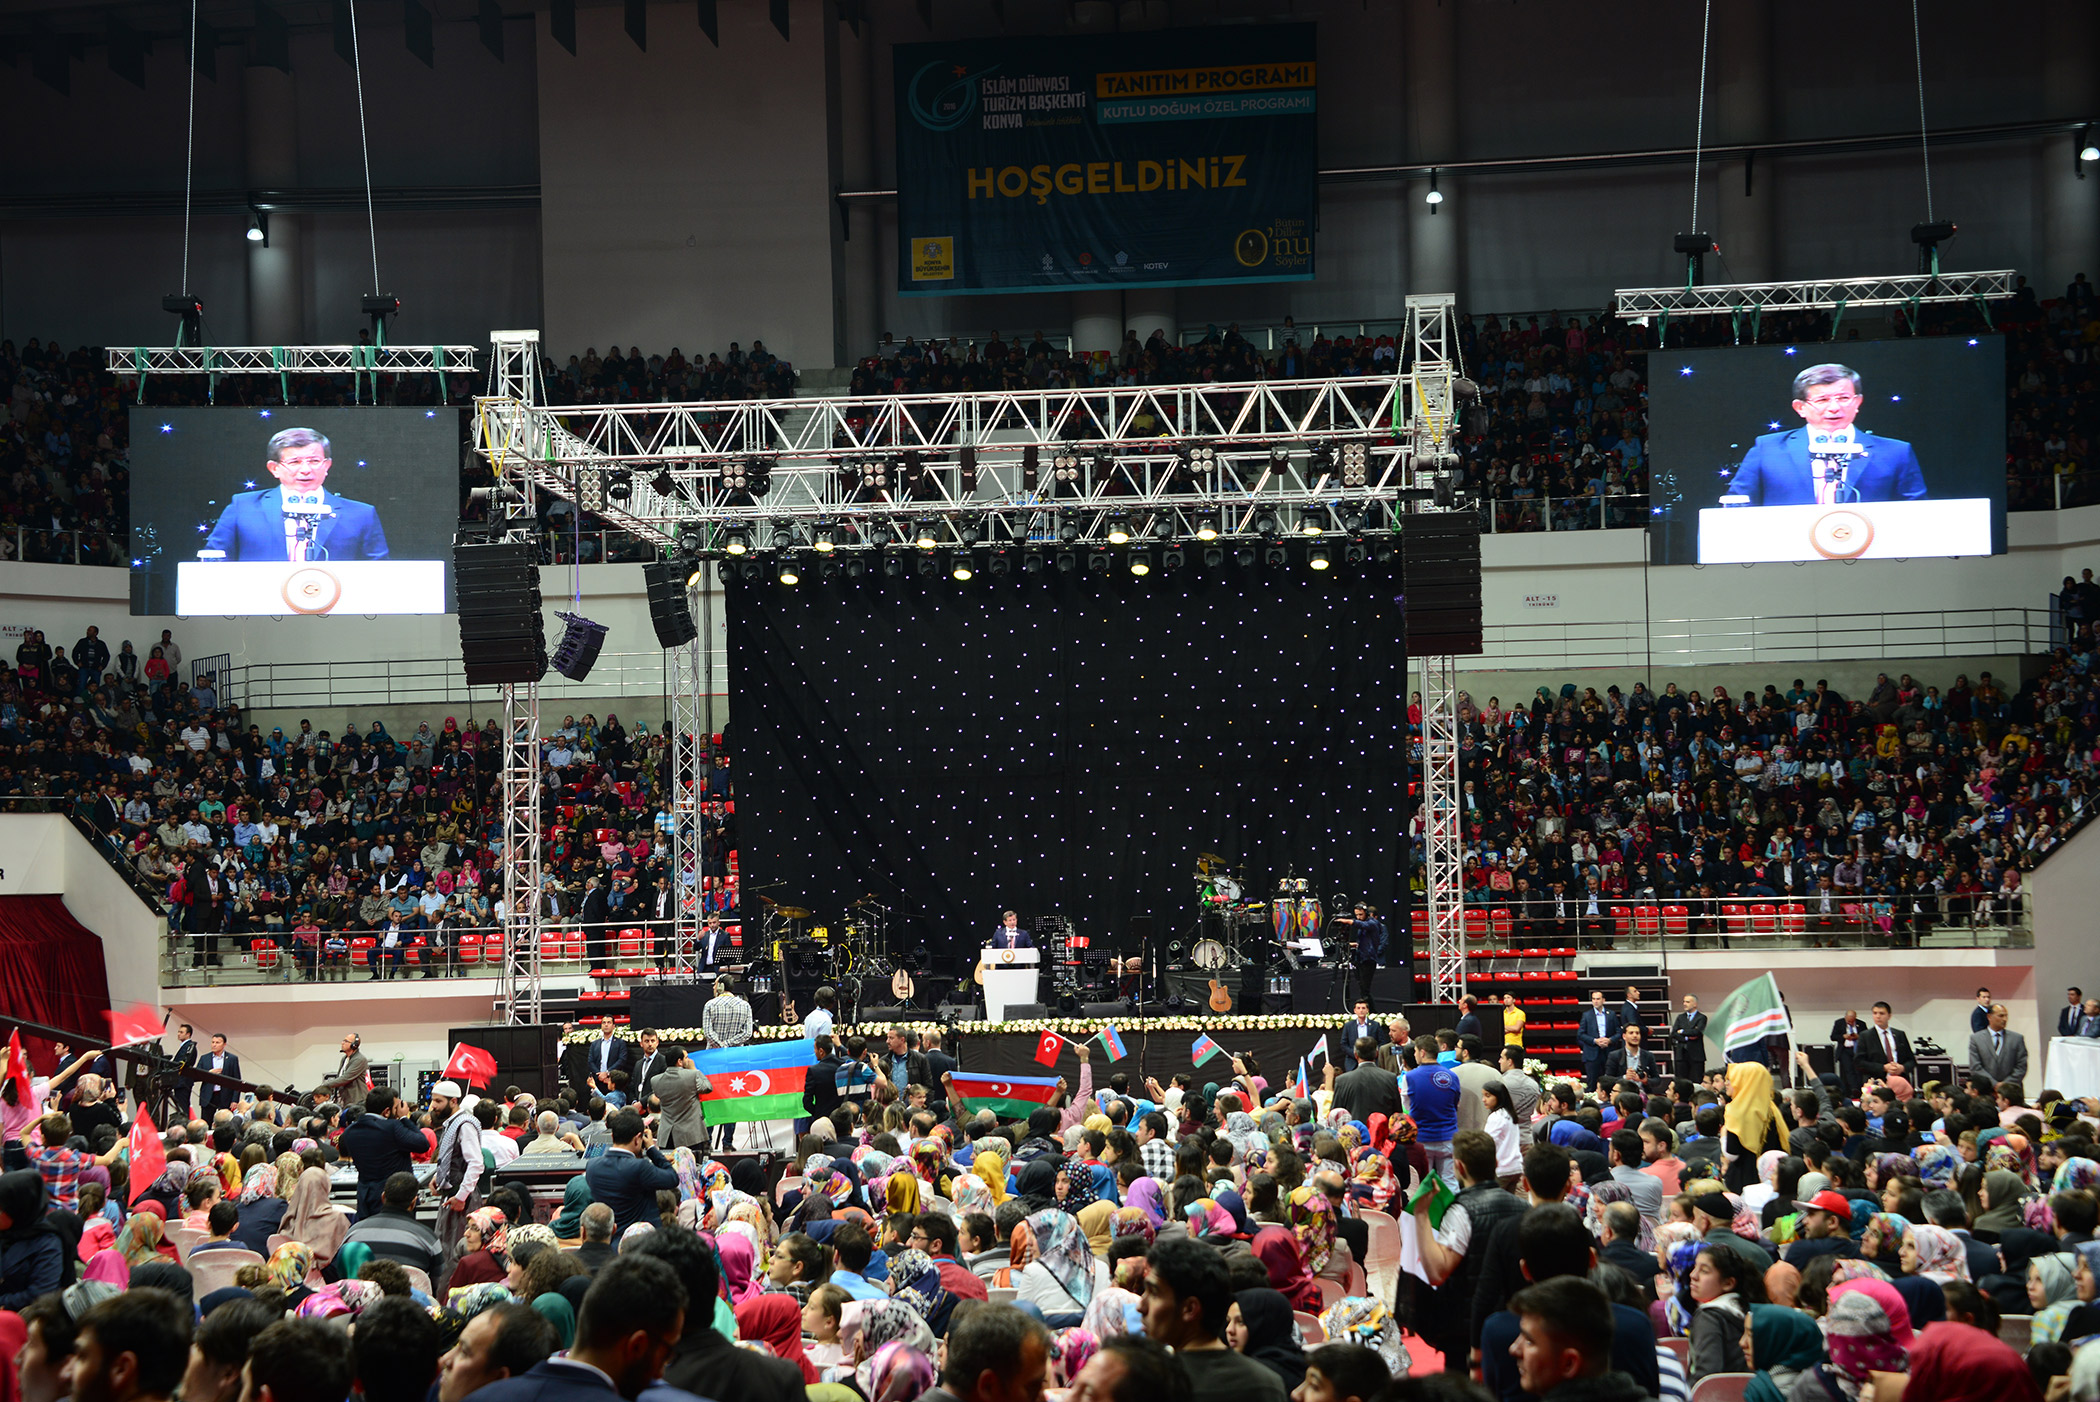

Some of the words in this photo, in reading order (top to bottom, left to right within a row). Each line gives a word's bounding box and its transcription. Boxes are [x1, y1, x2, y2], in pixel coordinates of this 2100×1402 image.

[1019, 74, 1069, 93] DÜNYASI
[1103, 74, 1189, 94] TANITIM
[1195, 65, 1310, 89] PROGRAMI
[1103, 105, 1146, 119] KUTLU
[1149, 100, 1201, 116] DOĞUM
[1203, 99, 1239, 113] ÖZEL
[1241, 96, 1310, 111] PROGRAMI
[982, 113, 1023, 130] KONYA
[1143, 262, 1169, 270] KOTEV
[1275, 255, 1307, 269] Söyler
